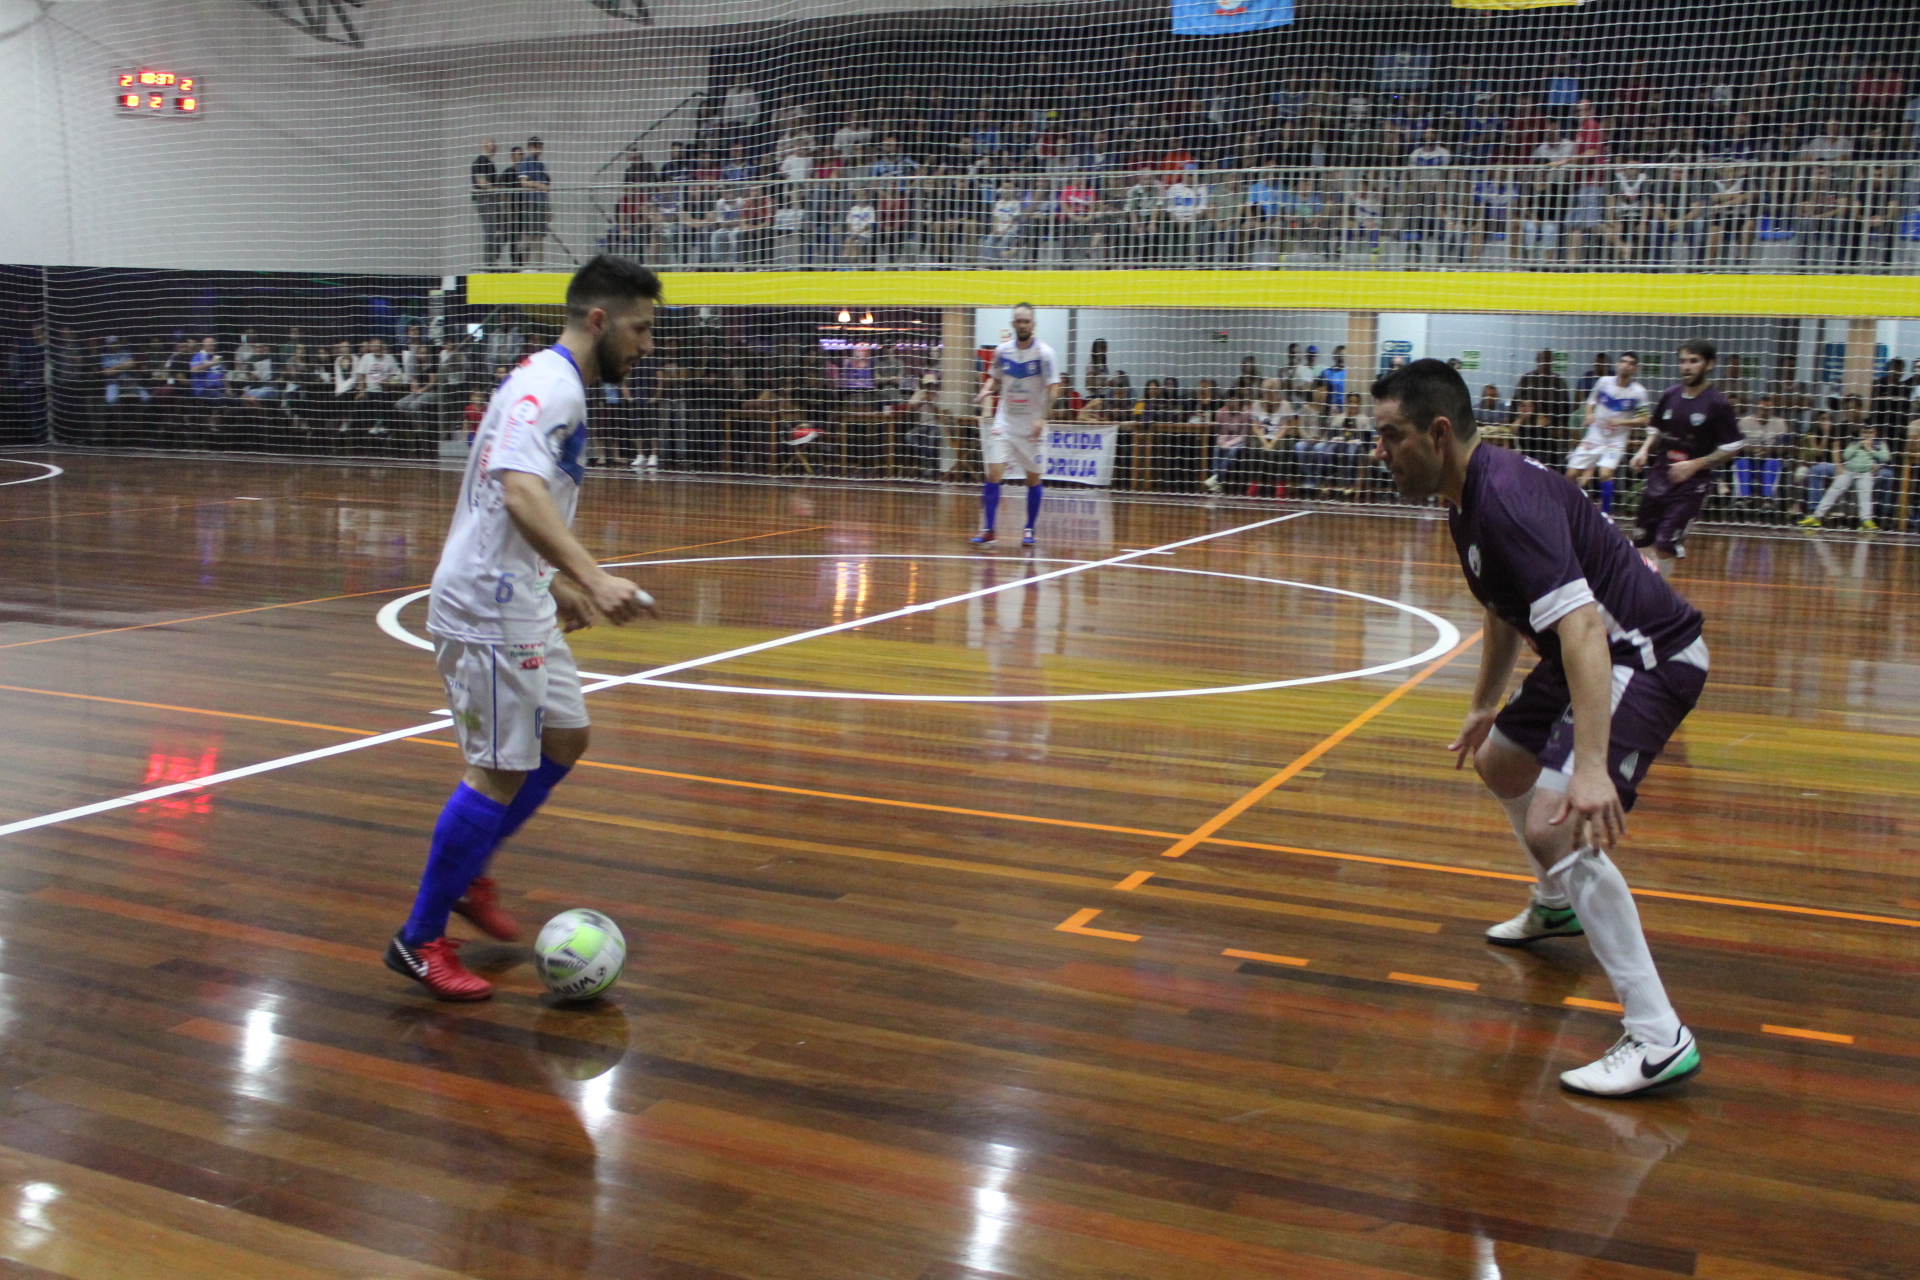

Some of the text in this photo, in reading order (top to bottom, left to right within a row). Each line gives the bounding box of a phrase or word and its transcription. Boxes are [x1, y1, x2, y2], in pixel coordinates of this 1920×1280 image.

[119, 74, 133, 87] 2
[179, 79, 193, 91] 2
[149, 96, 162, 108] 2
[495, 572, 515, 603] 6
